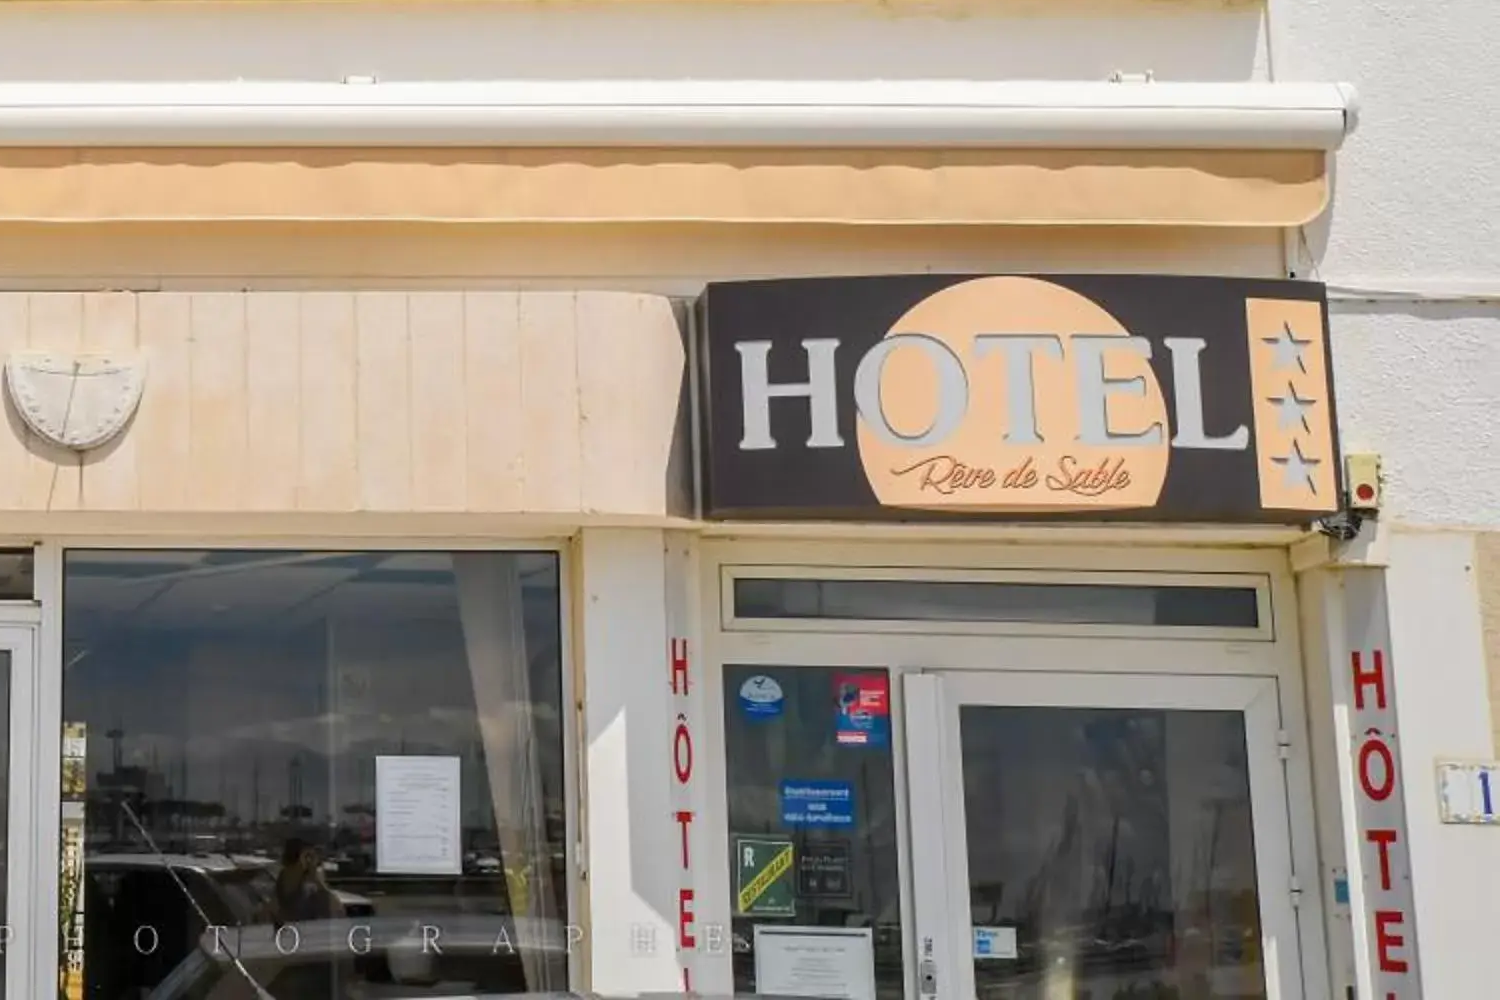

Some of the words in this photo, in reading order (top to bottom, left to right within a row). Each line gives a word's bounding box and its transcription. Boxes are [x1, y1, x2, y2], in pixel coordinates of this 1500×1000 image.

[733, 332, 1250, 451] HOTEL
[890, 455, 996, 495] Rêve
[1002, 456, 1039, 489] de
[1045, 454, 1132, 497] Sable
[1351, 650, 1409, 1000] HÔTE
[1478, 771, 1494, 815] 1
